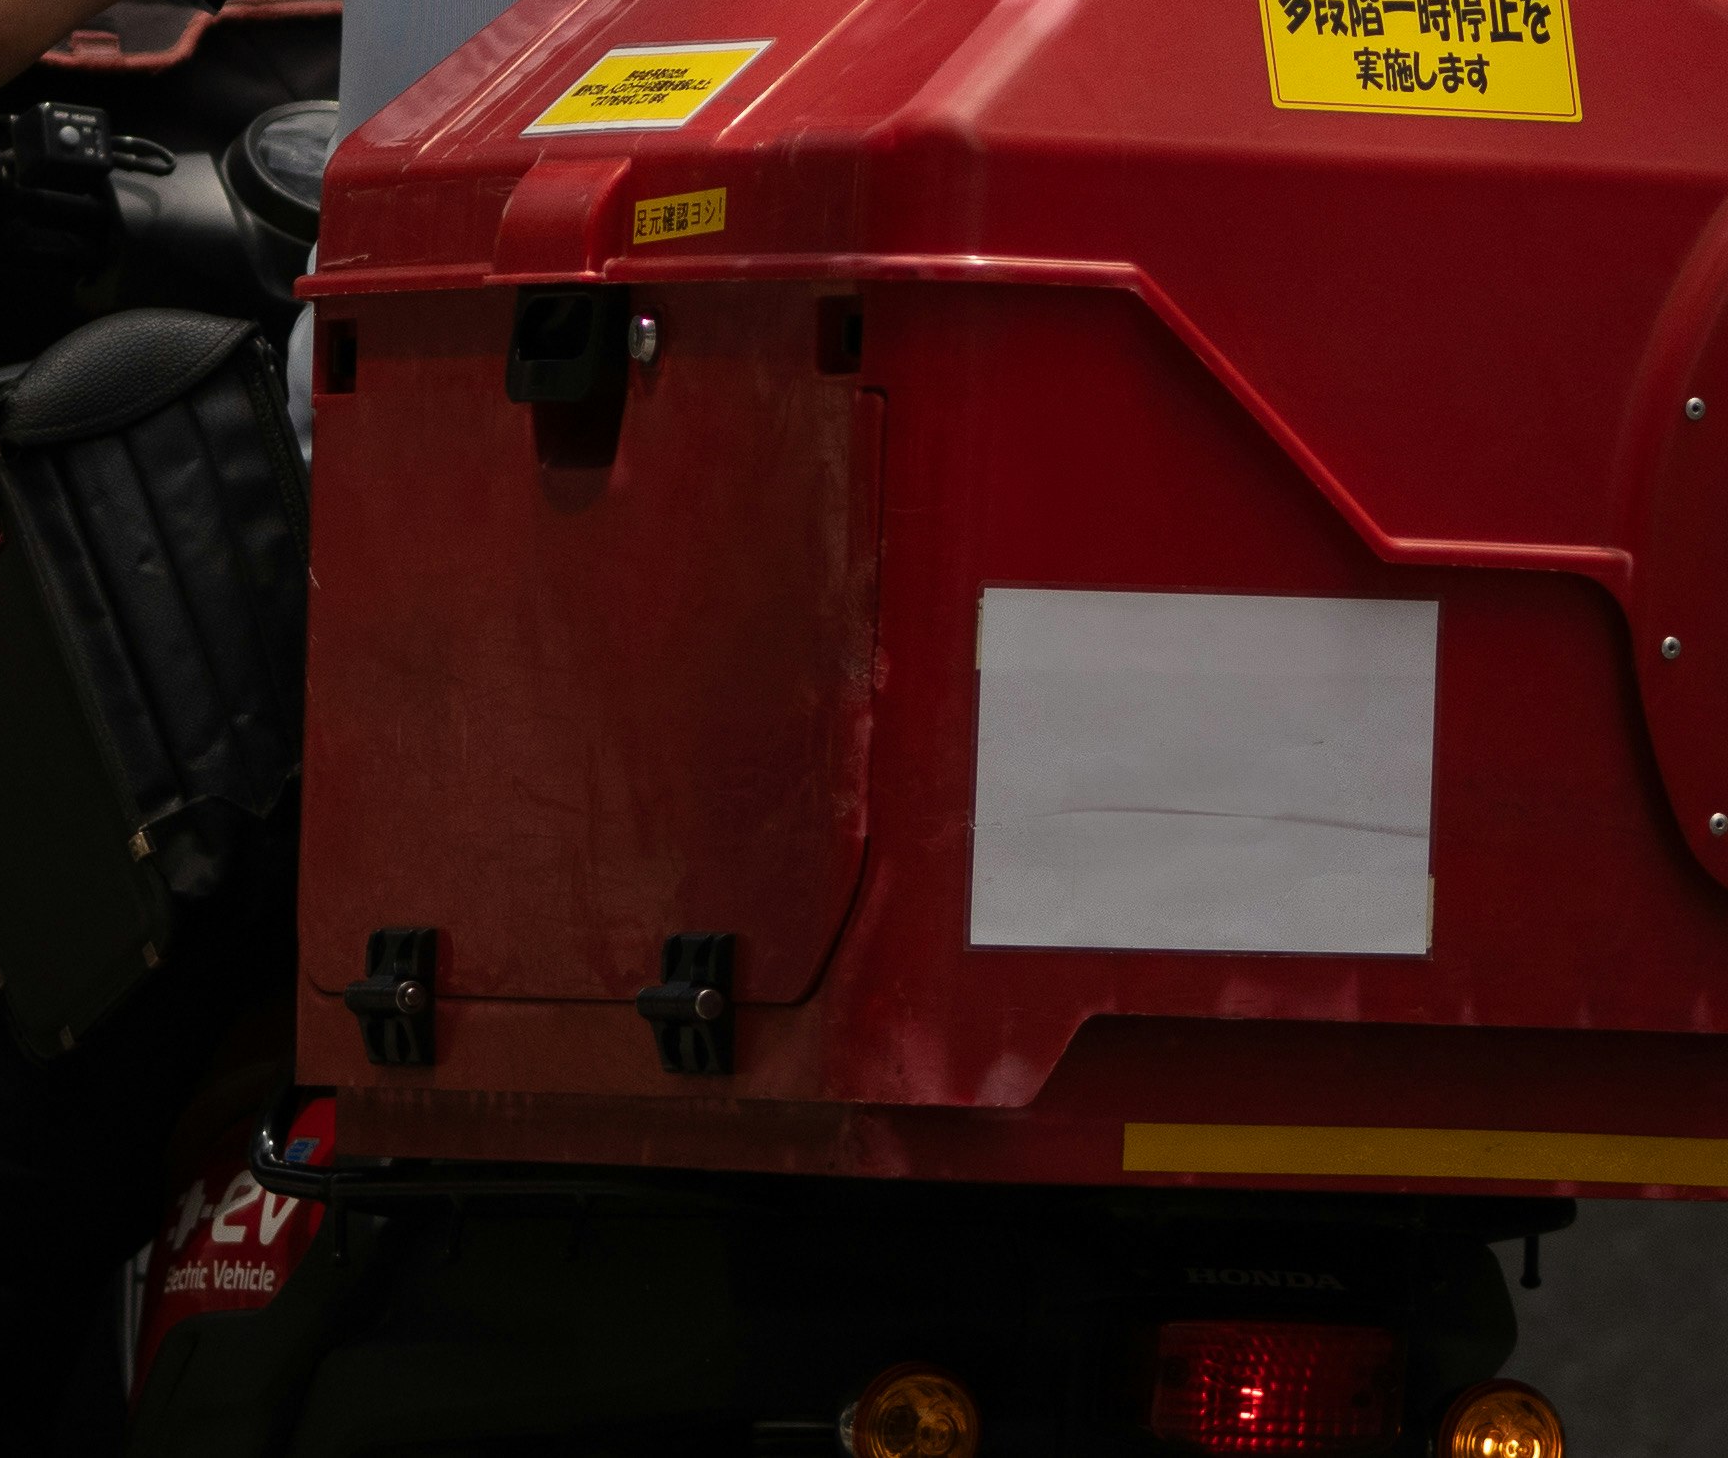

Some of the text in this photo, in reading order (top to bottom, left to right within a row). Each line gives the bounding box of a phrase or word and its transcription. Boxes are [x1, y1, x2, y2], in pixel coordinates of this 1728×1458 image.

[1353, 46, 1490, 95] 実施します
[213, 1259, 276, 1292] Vehicle
[1183, 1267, 1347, 1291] HONDA
